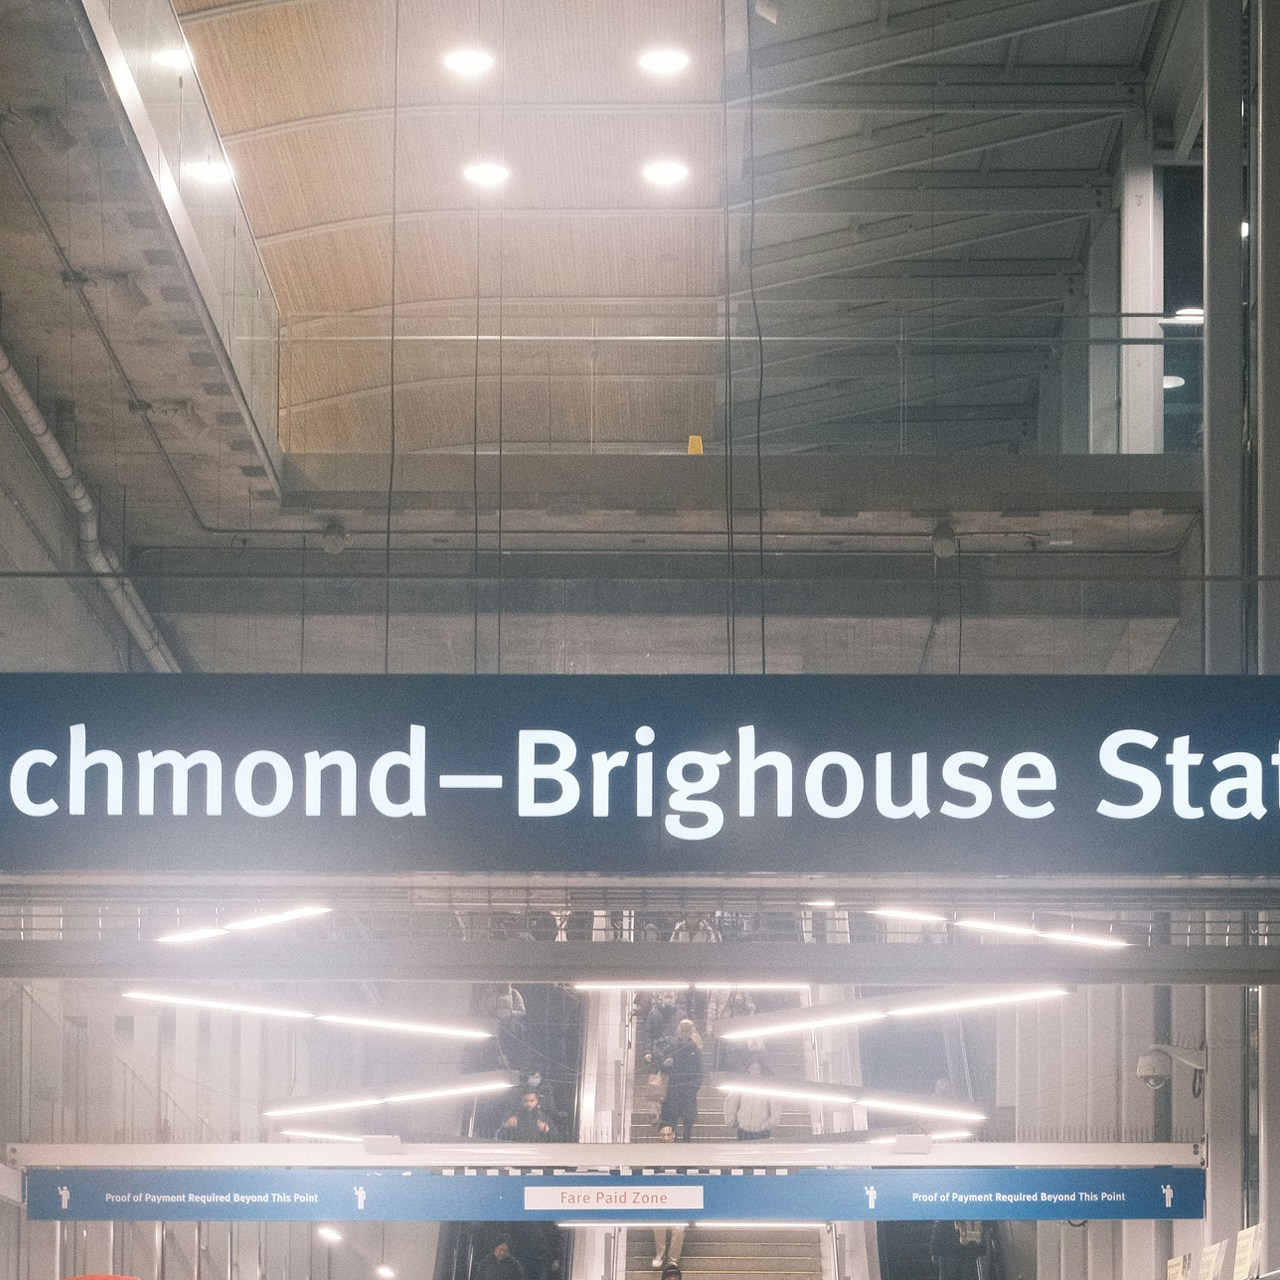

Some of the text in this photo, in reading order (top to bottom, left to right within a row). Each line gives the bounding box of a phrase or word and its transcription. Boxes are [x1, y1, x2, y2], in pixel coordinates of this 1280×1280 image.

[105, 1193, 318, 1204] Proof of Payment Required Beyond This Point
[560, 1191, 668, 1204] Fare Paid Zone
[912, 1192, 1125, 1204] Proof of Payment Required Beyond This Point
